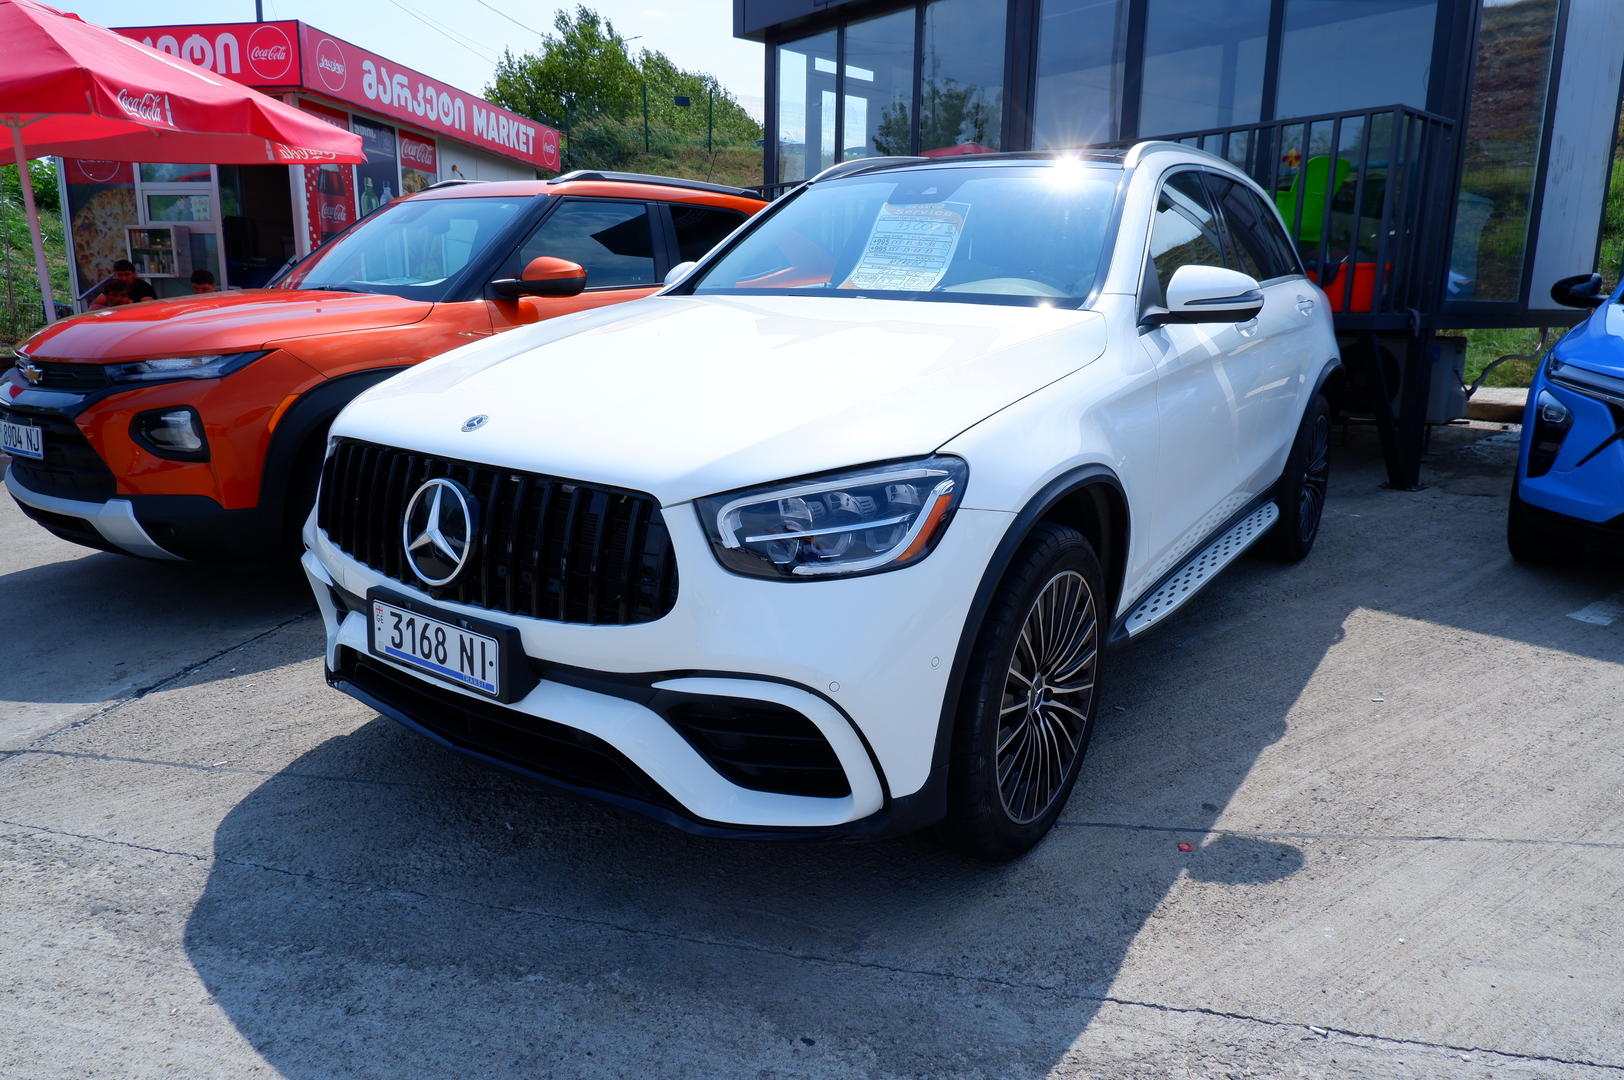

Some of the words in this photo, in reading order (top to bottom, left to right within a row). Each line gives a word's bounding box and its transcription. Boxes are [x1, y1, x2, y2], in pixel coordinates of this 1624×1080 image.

[251, 45, 287, 61] Coca-Cola
[116, 88, 162, 123] Coca-Cola
[362, 59, 466, 132] მარკეტი
[473, 104, 535, 155] MARKET
[400, 138, 433, 165] Coca-Cola
[321, 202, 347, 221] Coca-Cola
[895, 205, 953, 217] Service
[3, 424, 23, 449] 8904
[26, 428, 40, 452] NJ
[390, 610, 448, 665] 3168
[459, 634, 487, 681] NI
